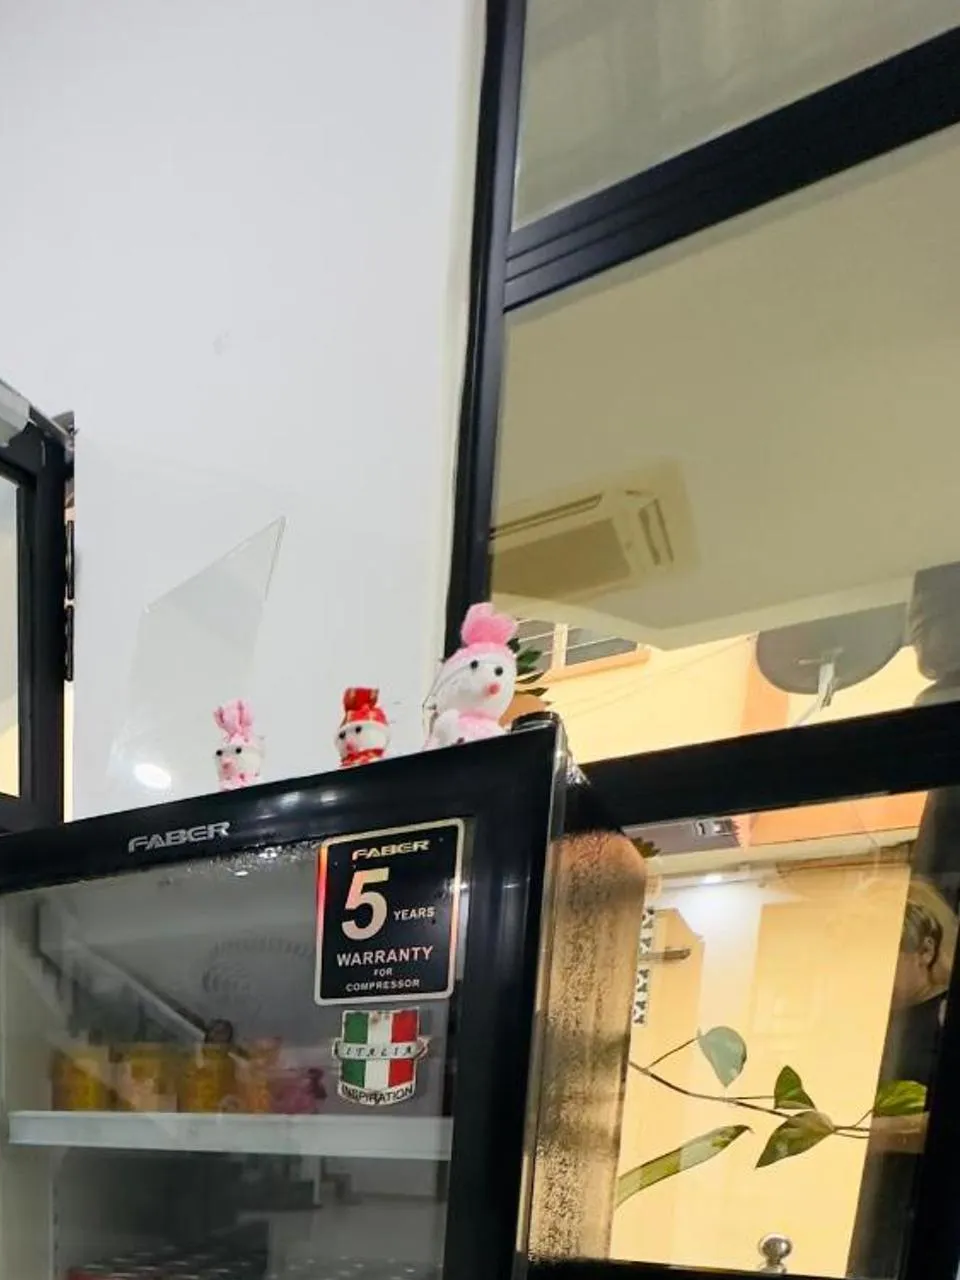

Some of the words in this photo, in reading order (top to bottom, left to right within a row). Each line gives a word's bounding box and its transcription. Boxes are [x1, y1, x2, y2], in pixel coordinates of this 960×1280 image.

[128, 821, 231, 853] FABER
[351, 839, 430, 860] FABER
[341, 867, 389, 941] 5
[394, 907, 436, 921] YEARS
[336, 946, 433, 967] WARRANTY
[374, 968, 393, 977] FOR
[345, 978, 420, 992] COMPRESSOR
[341, 1083, 414, 1104] INSPIRATION
